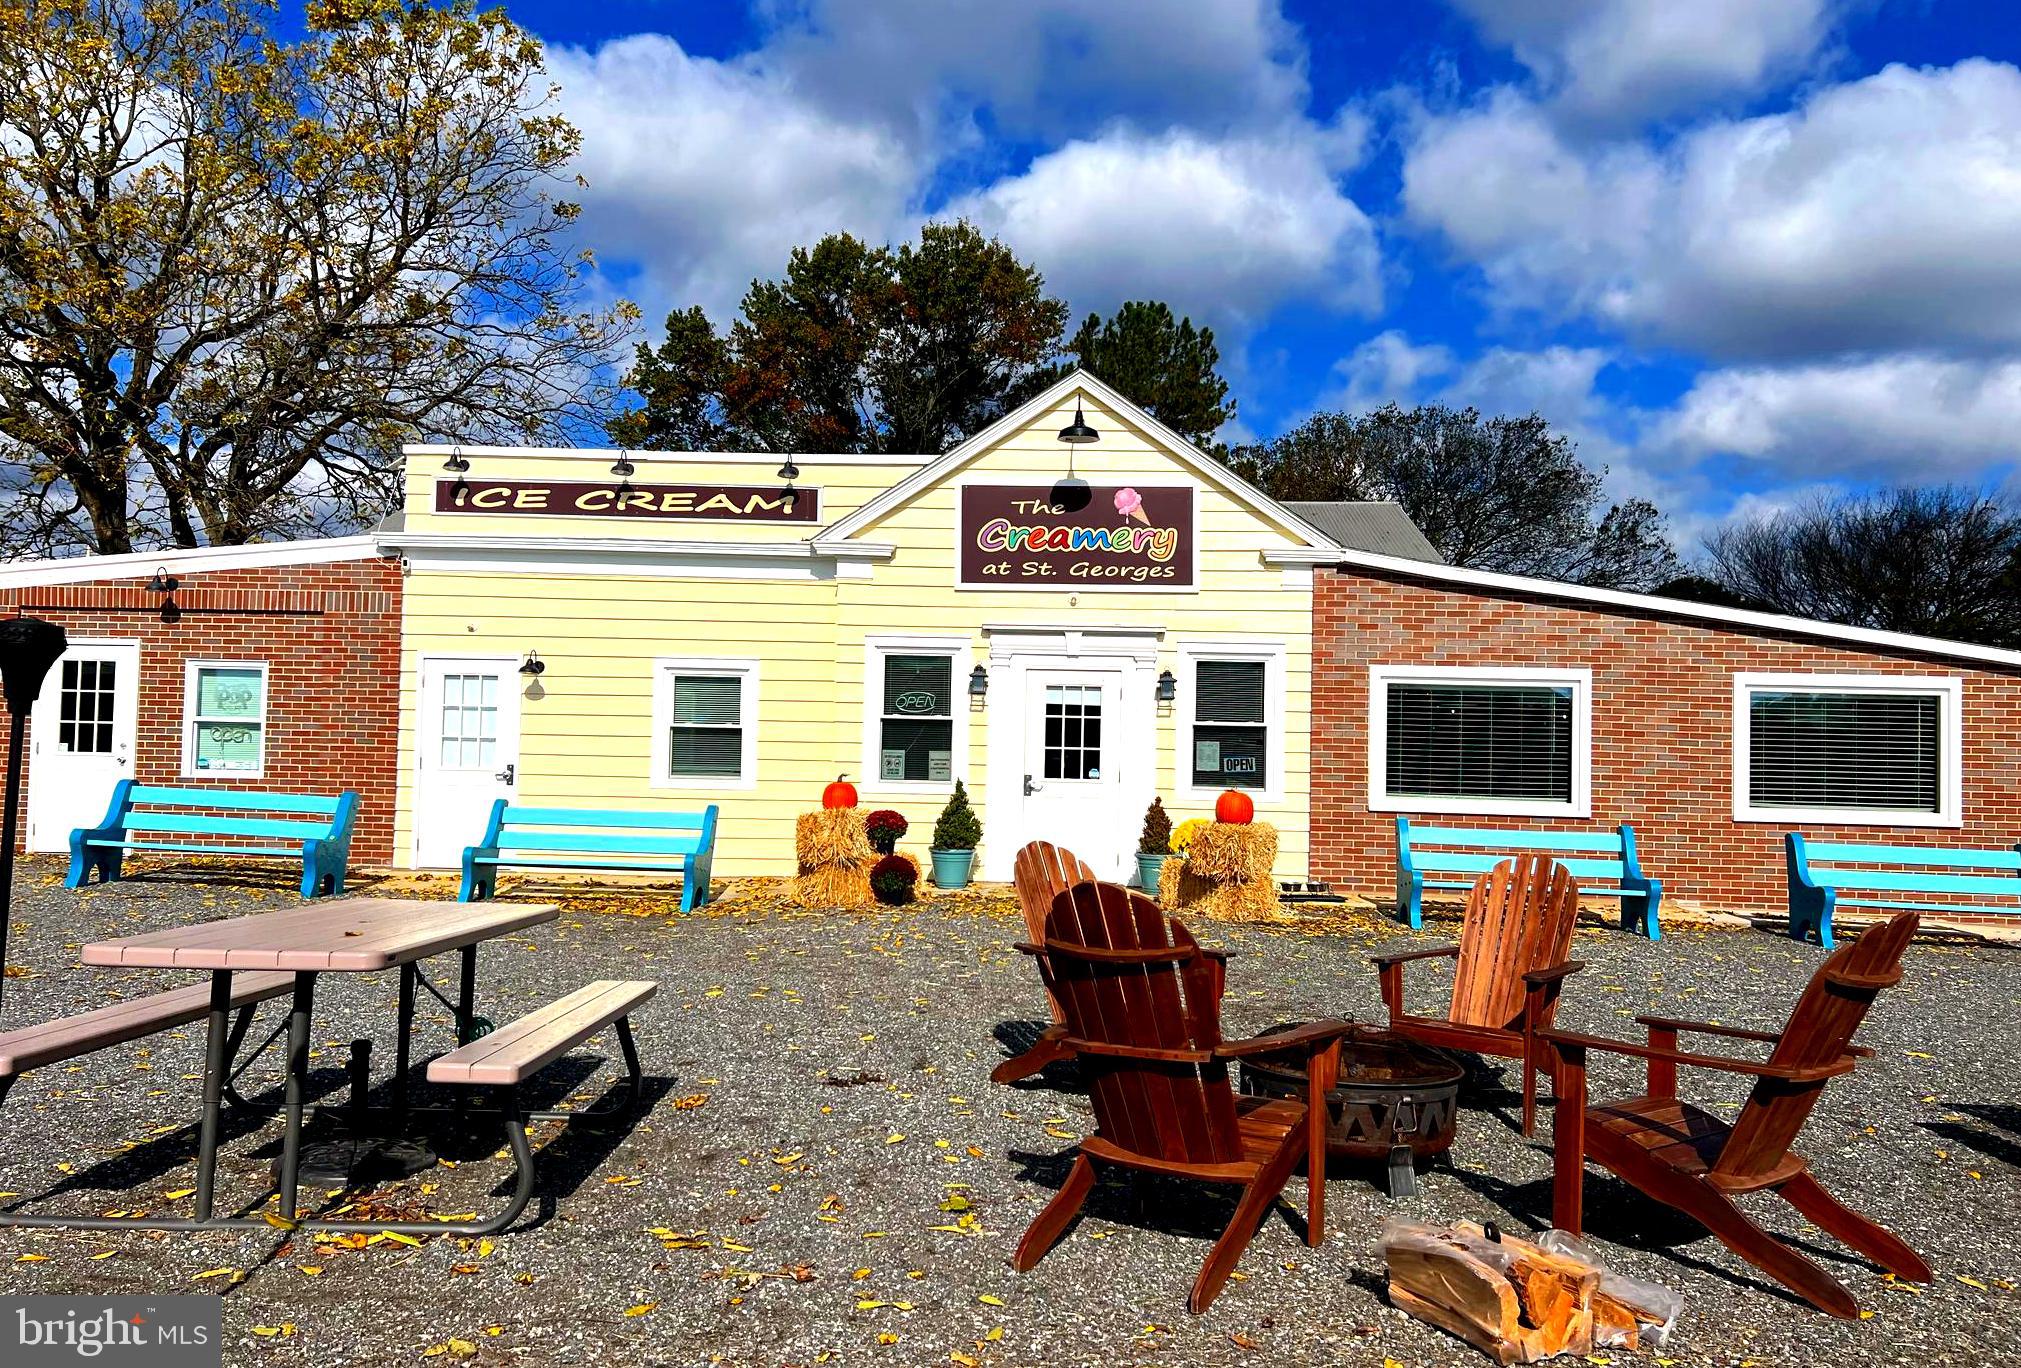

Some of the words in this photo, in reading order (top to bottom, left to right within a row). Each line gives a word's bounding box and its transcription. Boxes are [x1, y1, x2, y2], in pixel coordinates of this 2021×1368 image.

[454, 487, 551, 509] ICE
[575, 489, 795, 514] CREAM
[1011, 499, 1066, 515] The
[976, 518, 1178, 562] Creamery
[982, 561, 1012, 576] at
[1021, 562, 1057, 577] St.
[1069, 561, 1175, 581] Georges
[895, 696, 937, 707] OPEN
[210, 726, 253, 751] open
[1226, 758, 1254, 771] OPEN
